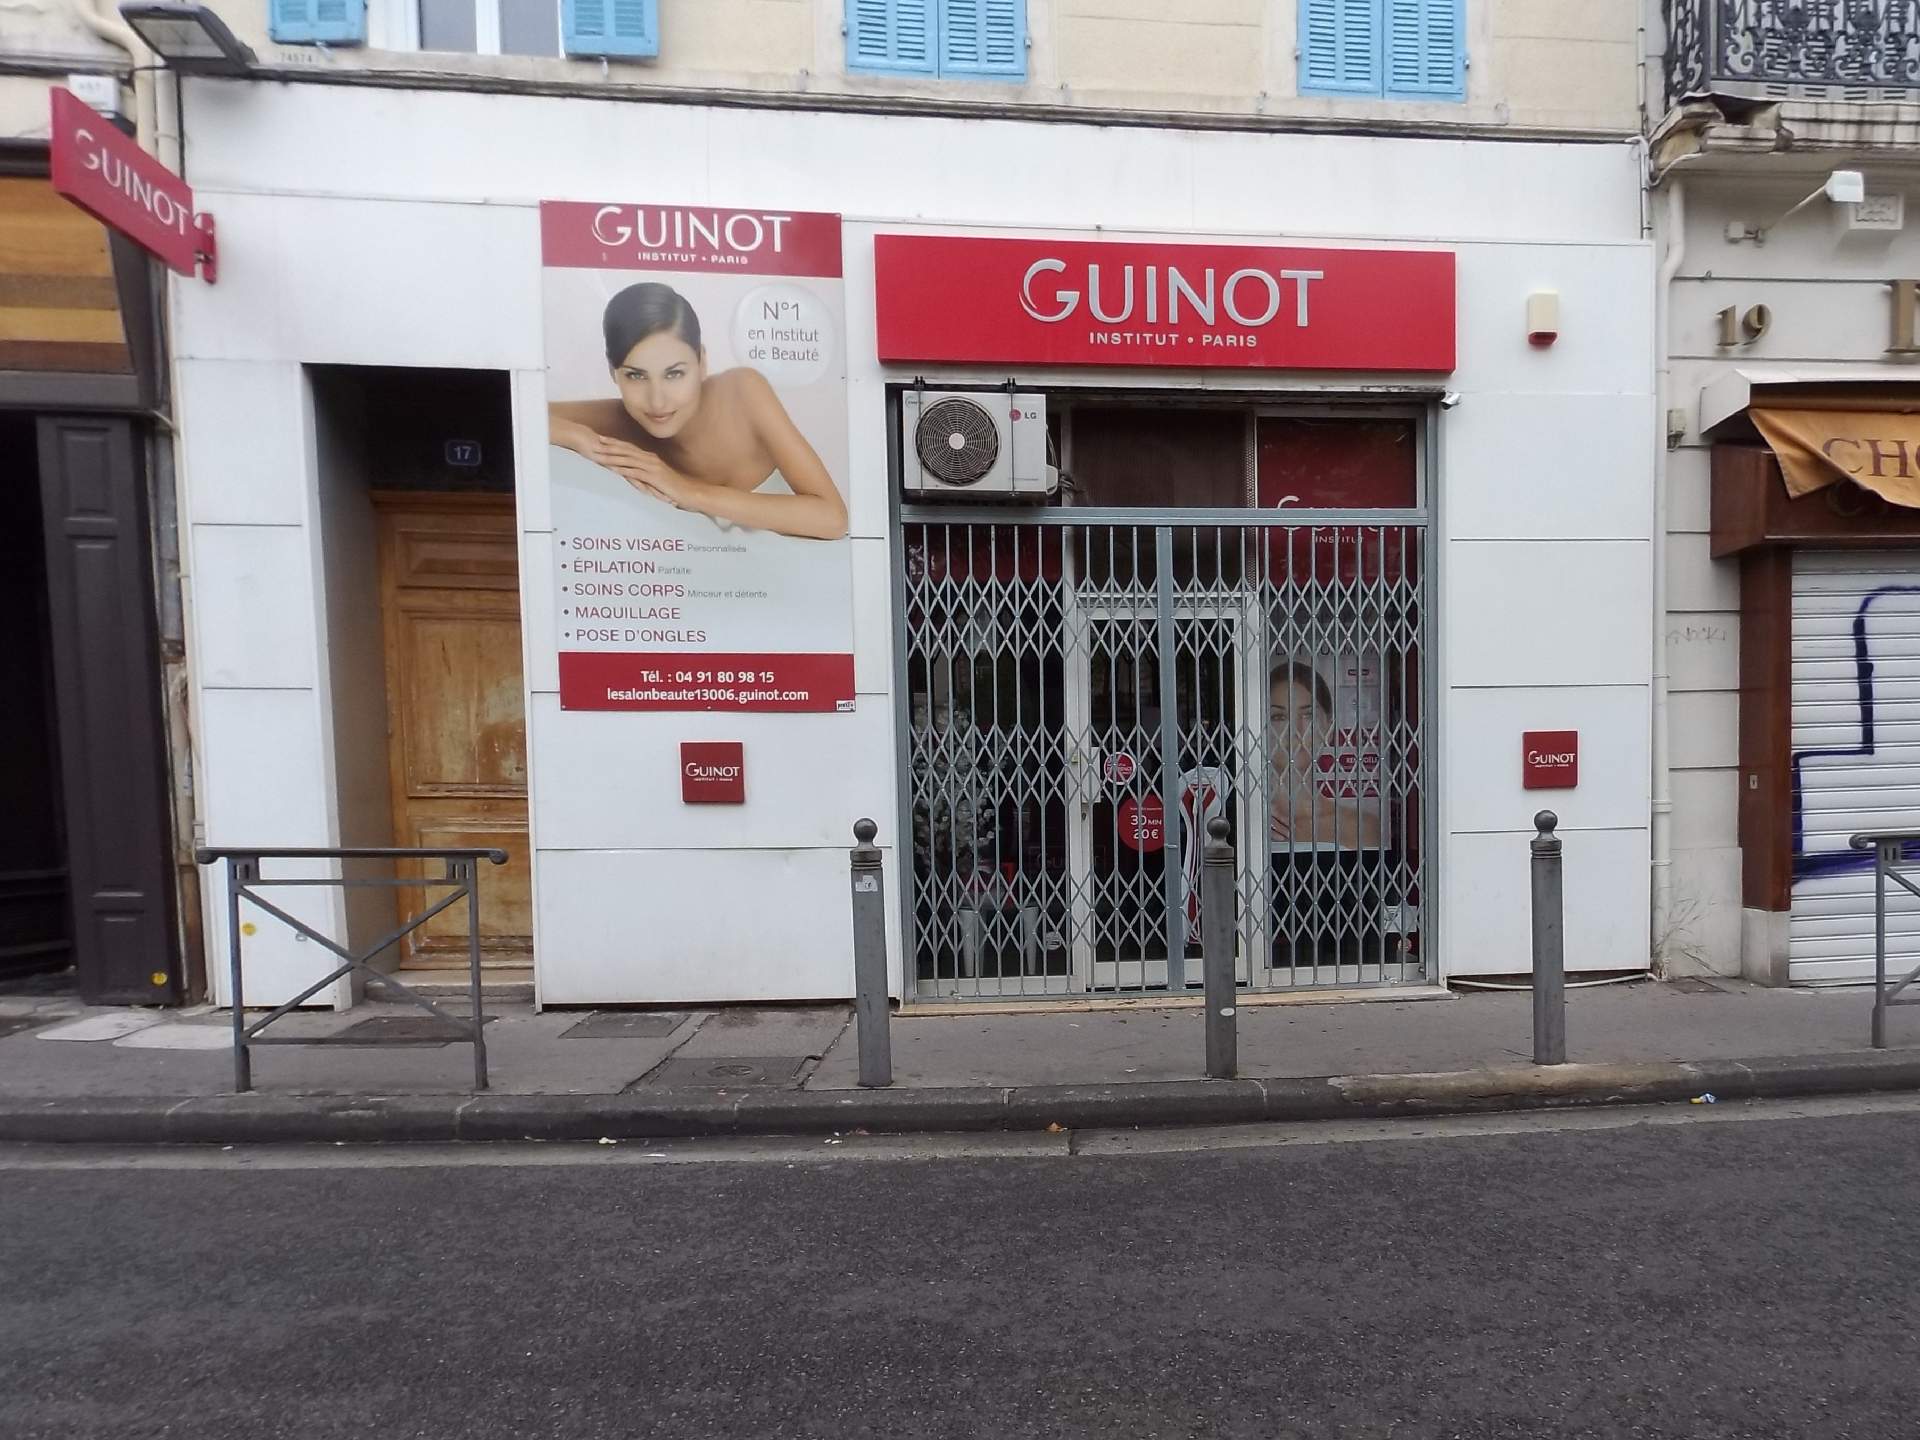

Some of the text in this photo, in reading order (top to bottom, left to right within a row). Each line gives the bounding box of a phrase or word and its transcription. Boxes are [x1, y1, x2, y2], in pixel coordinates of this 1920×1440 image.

[75, 128, 189, 236] GUINOT
[591, 205, 792, 253] GUINOT
[637, 251, 749, 265] INSTITUT PARIS
[1018, 257, 1325, 329] GUINOT
[762, 301, 801, 322] N°1
[1715, 302, 1773, 349] 19
[747, 326, 819, 343] en Institut
[1089, 331, 1258, 348] INSTITUT PARIS
[748, 347, 820, 363] de Beauté
[1024, 412, 1038, 420] LG
[453, 445, 472, 460] 17
[1822, 437, 1920, 479] CH
[571, 536, 622, 552] SOINS
[626, 538, 685, 552] VISAGE
[572, 557, 656, 575] ÉPILATION
[573, 583, 624, 597] SOINS
[627, 583, 685, 598] CORPS
[575, 606, 681, 621] MAQUILLAGE
[575, 629, 707, 643] POSE D'ONGLES
[640, 669, 664, 683] Tél.
[675, 670, 693, 683] 04
[697, 670, 712, 683] 91
[717, 670, 734, 683] 80
[738, 670, 755, 683] 98
[758, 670, 775, 683] 15
[607, 687, 809, 704] lesalonbeaute13006.guinot.com
[1527, 750, 1576, 764] GUINOT
[685, 762, 741, 777] GUINOT
